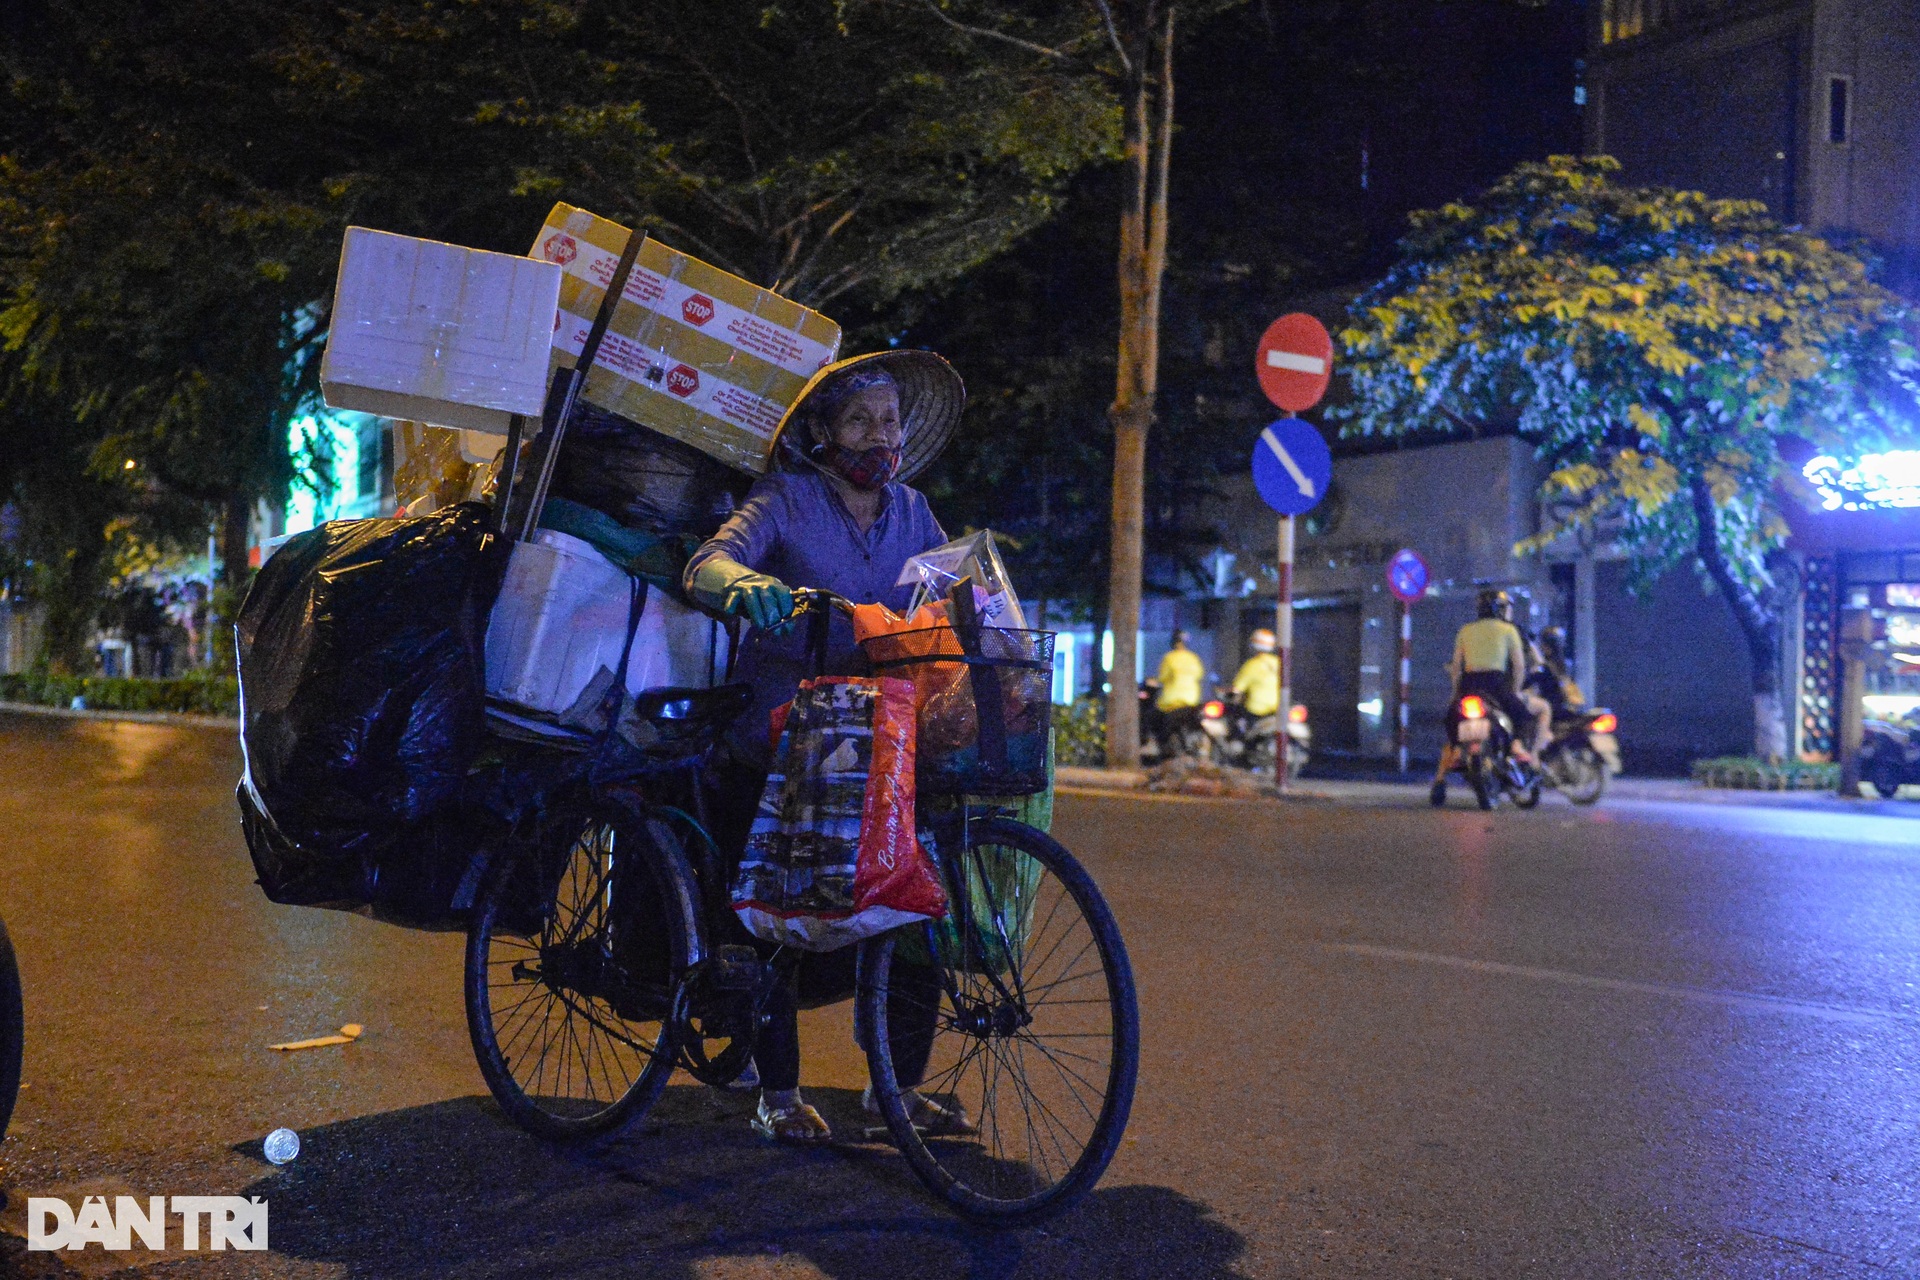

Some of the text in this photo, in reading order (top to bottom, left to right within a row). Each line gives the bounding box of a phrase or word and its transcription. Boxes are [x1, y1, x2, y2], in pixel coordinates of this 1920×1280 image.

[547, 240, 574, 259] STOP
[590, 264, 610, 277] Check
[636, 269, 660, 284] Broken
[624, 286, 651, 301] Receipt
[685, 300, 711, 319] STOP
[742, 323, 771, 340] Package
[771, 336, 803, 354] Damaged
[750, 319, 765, 330] Seal
[773, 329, 797, 344] Broken
[727, 324, 802, 361] Check Contents Before
[736, 336, 787, 362] Signing Receipt
[671, 371, 696, 389] STOP
[726, 394, 755, 411] Package
[735, 391, 750, 400] Seal
[712, 395, 732, 408] Check
[734, 405, 763, 422] Contents
[721, 407, 746, 422] Signing
[878, 816, 898, 871] Bassin
